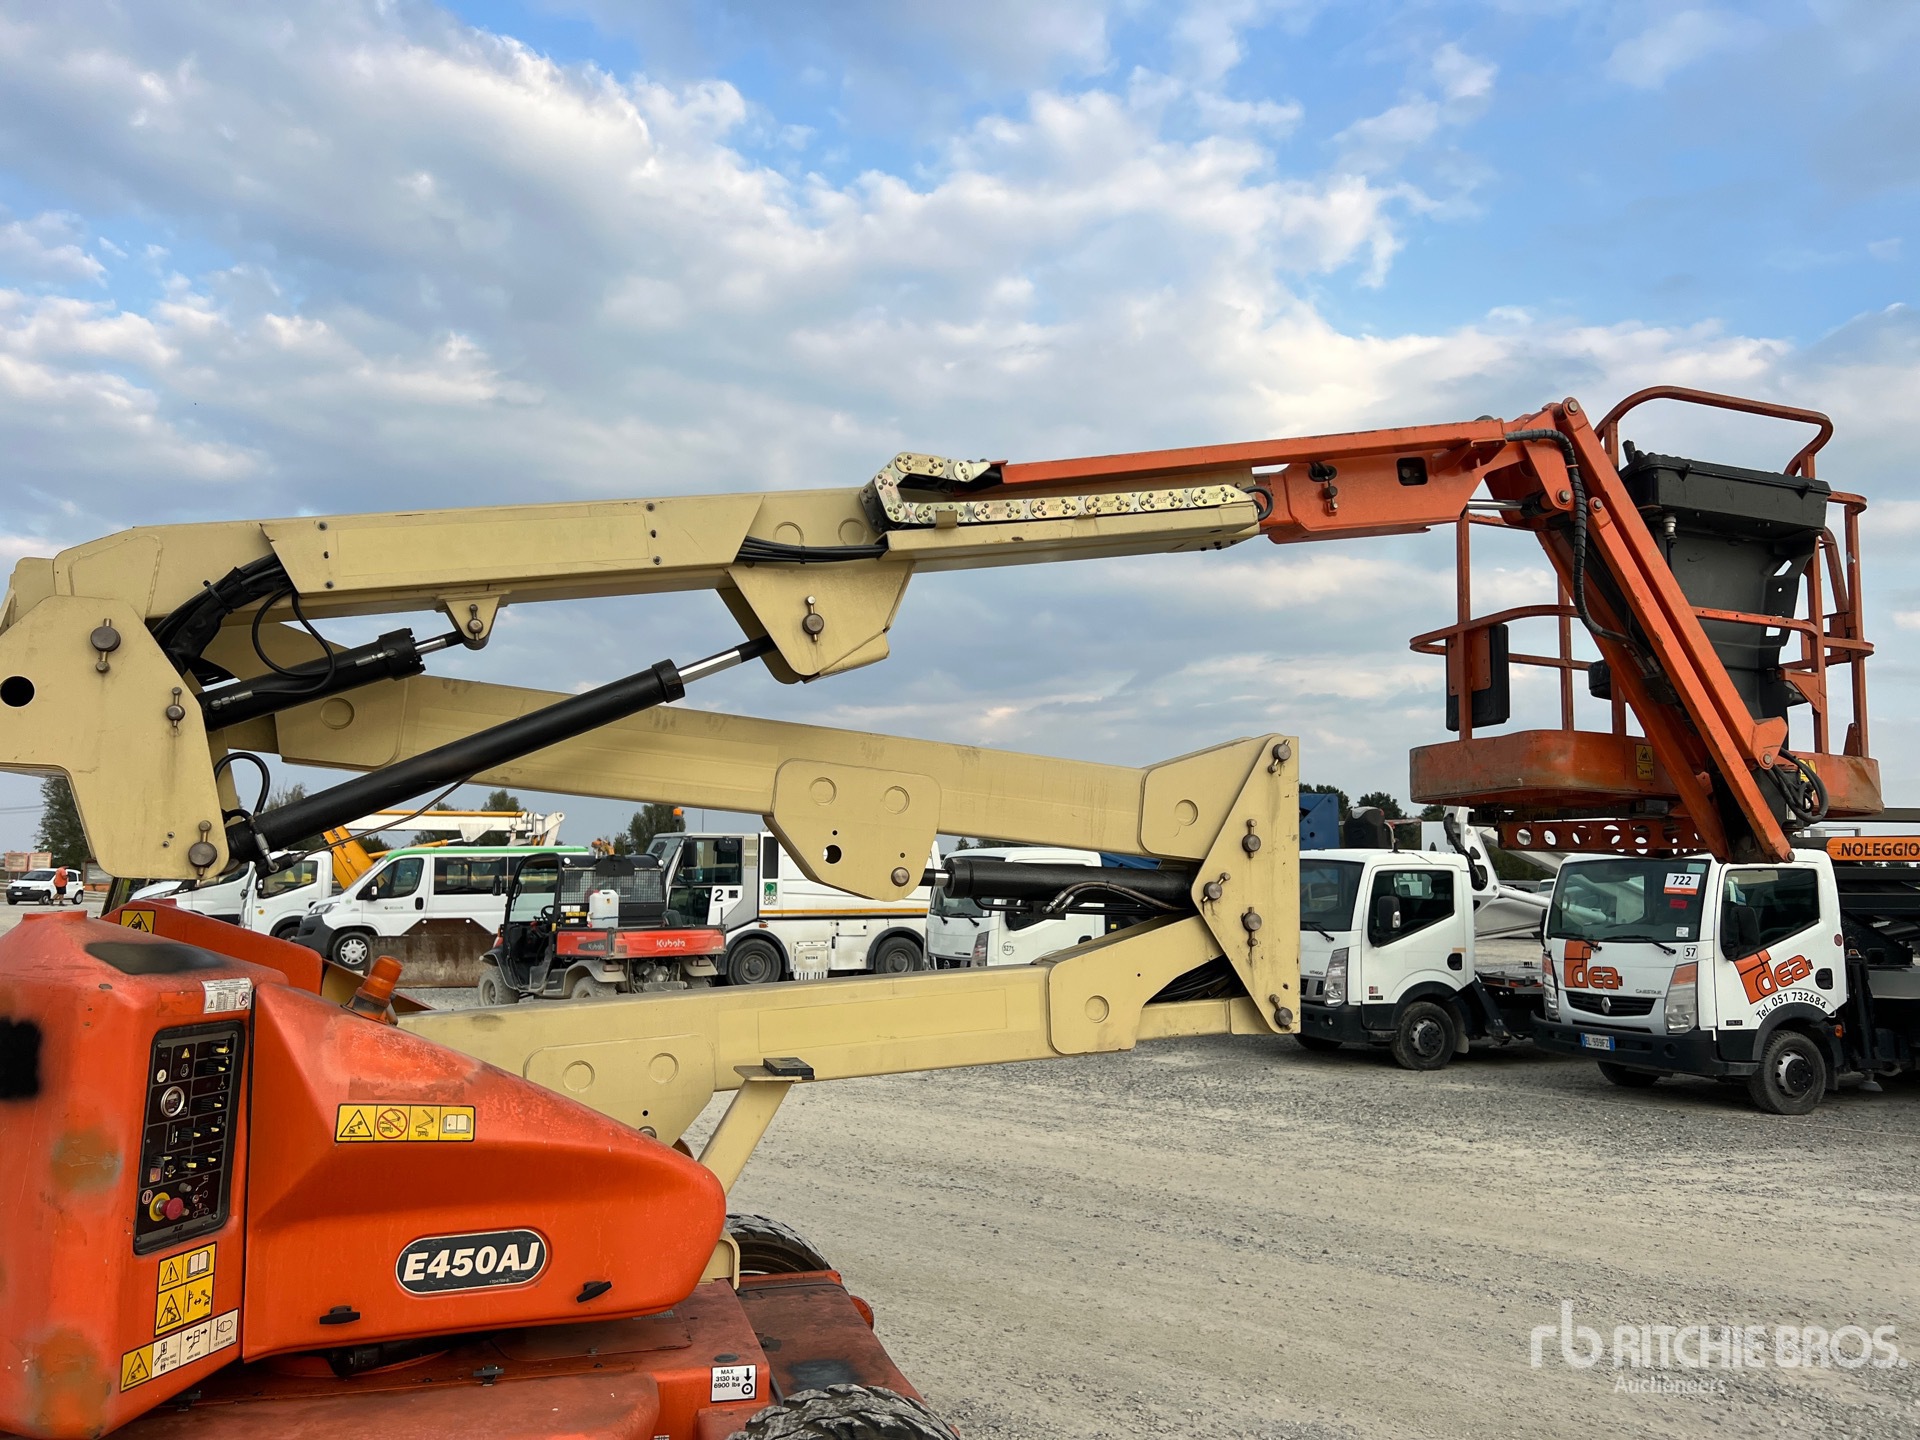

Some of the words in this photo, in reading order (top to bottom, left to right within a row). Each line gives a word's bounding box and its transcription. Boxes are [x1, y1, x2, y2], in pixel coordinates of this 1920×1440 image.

[1672, 875, 1692, 886] 722
[714, 889, 724, 902] 2
[656, 939, 686, 947] Kubota
[1685, 947, 1697, 957] 57
[1755, 1004, 1772, 1020] Tel.
[1771, 993, 1789, 1007] 051
[1791, 991, 1827, 1009] 732684
[402, 1241, 540, 1282] E450AJ
